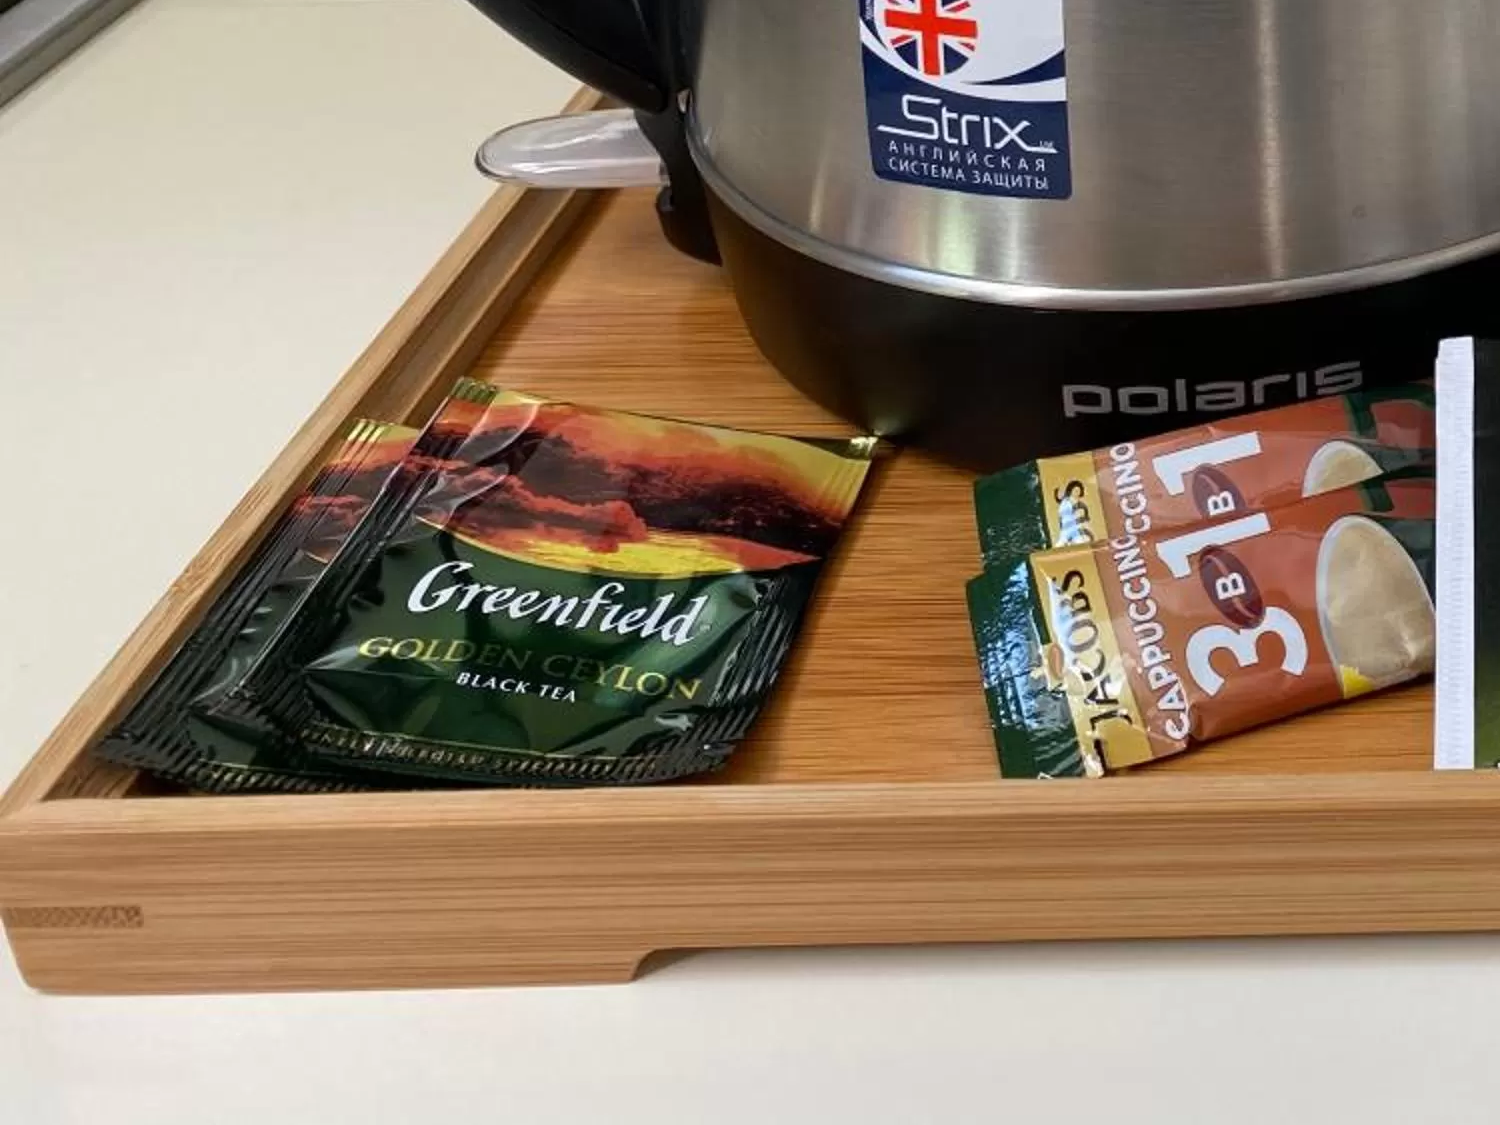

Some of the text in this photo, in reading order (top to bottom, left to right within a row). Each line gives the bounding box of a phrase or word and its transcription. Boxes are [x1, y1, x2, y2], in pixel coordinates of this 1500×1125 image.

[876, 94, 1058, 154] Strix
[888, 140, 1046, 172] АНГЛИЙСКАЯ
[889, 157, 1049, 190] СИСТЕМА ЗАЩИТЫ
[1062, 361, 1363, 418] polaris
[1109, 441, 1153, 534] CCINO
[1155, 512, 1271, 579] 1
[407, 561, 709, 646] Greenfield
[358, 635, 702, 701] GOLDEN CEYLON
[1186, 606, 1308, 697] 3
[456, 671, 578, 704] BLACK TEA
